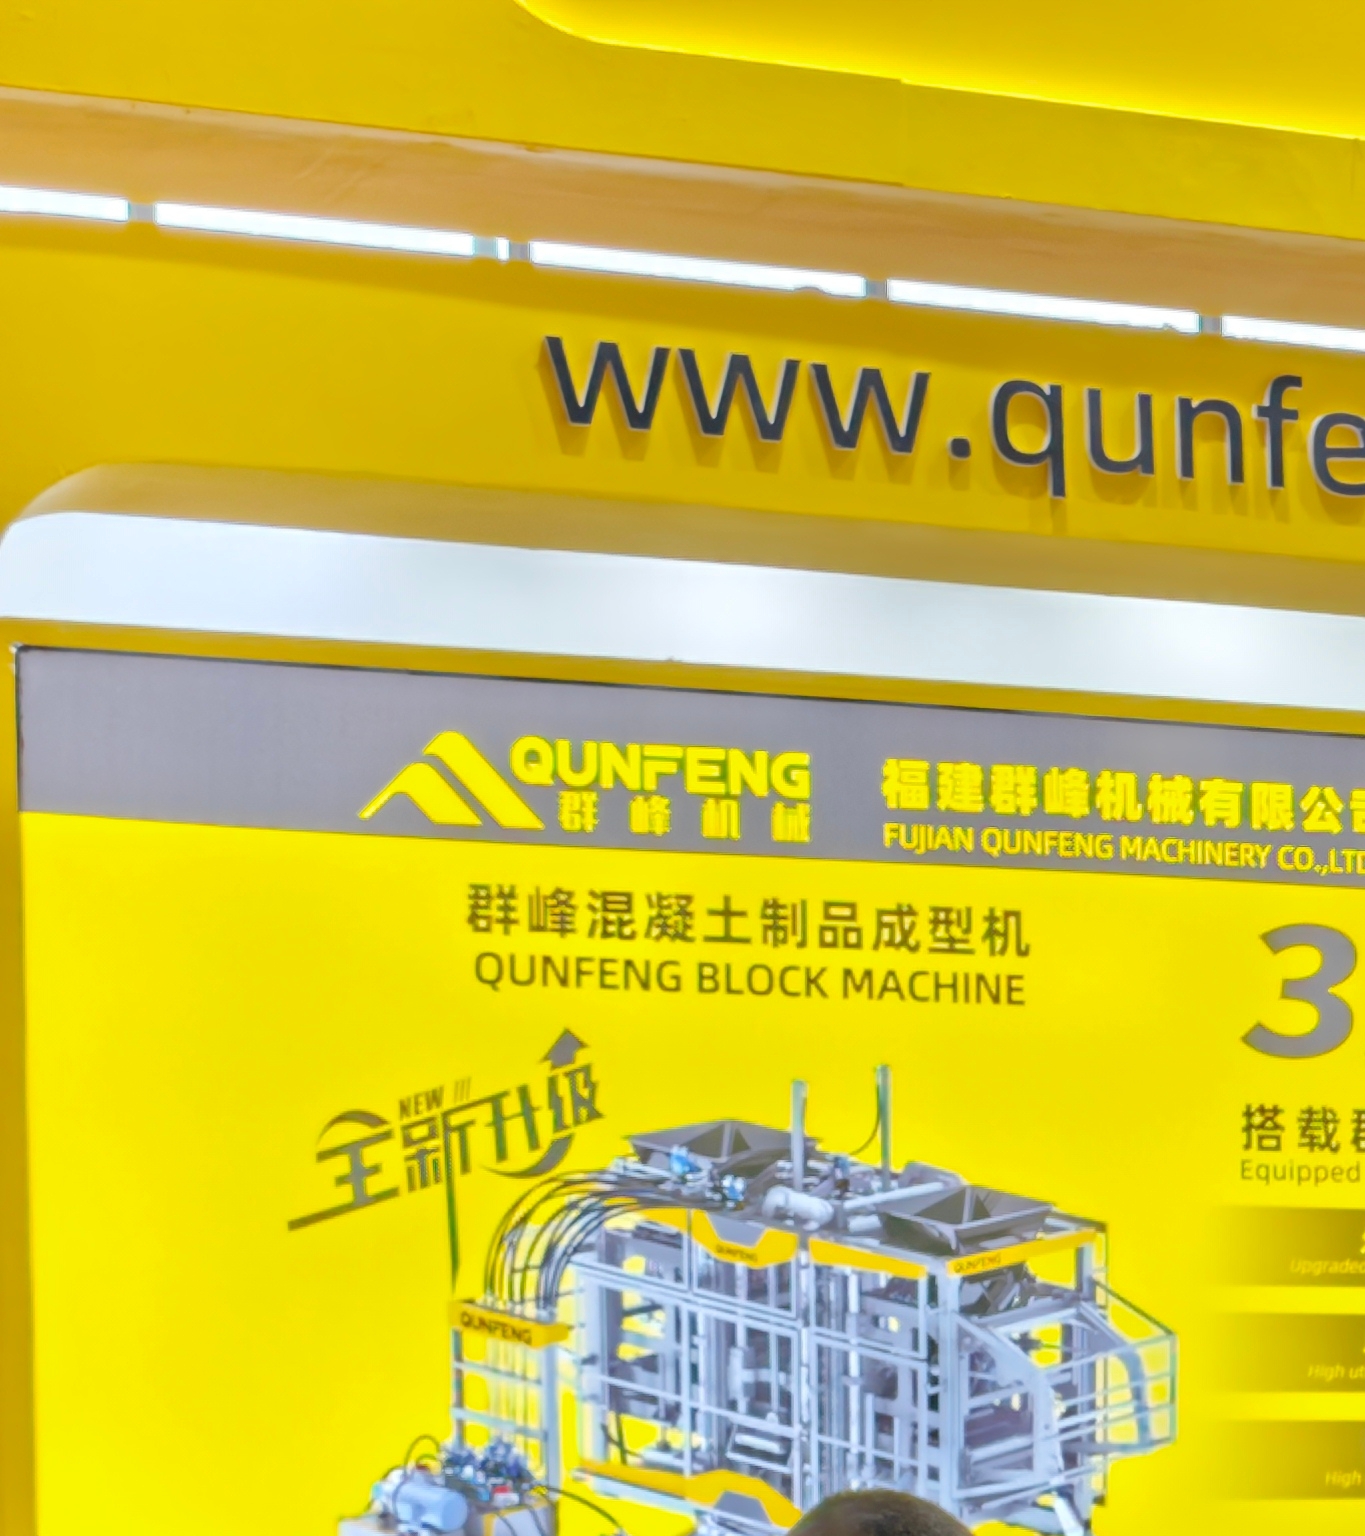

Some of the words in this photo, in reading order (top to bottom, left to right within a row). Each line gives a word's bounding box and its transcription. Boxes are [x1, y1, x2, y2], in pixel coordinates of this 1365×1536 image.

[510, 735, 811, 799] QUNFENG
[557, 790, 811, 843] 群峰机械
[882, 823, 975, 853] FUJIAN
[981, 827, 1114, 860] QUNFENG
[1120, 837, 1272, 869] MACHINERY
[466, 883, 1030, 957] 群峰混凝土制品成型机
[474, 951, 683, 994] QUNFENG
[697, 960, 830, 999] BLOCK
[841, 967, 1026, 1007] MACHINE
[398, 1085, 445, 1121] NEW
[288, 1062, 605, 1232] 全新升级
[1240, 1158, 1361, 1188] Equipped
[1308, 1363, 1346, 1381] High
[1325, 1470, 1364, 1487] High
